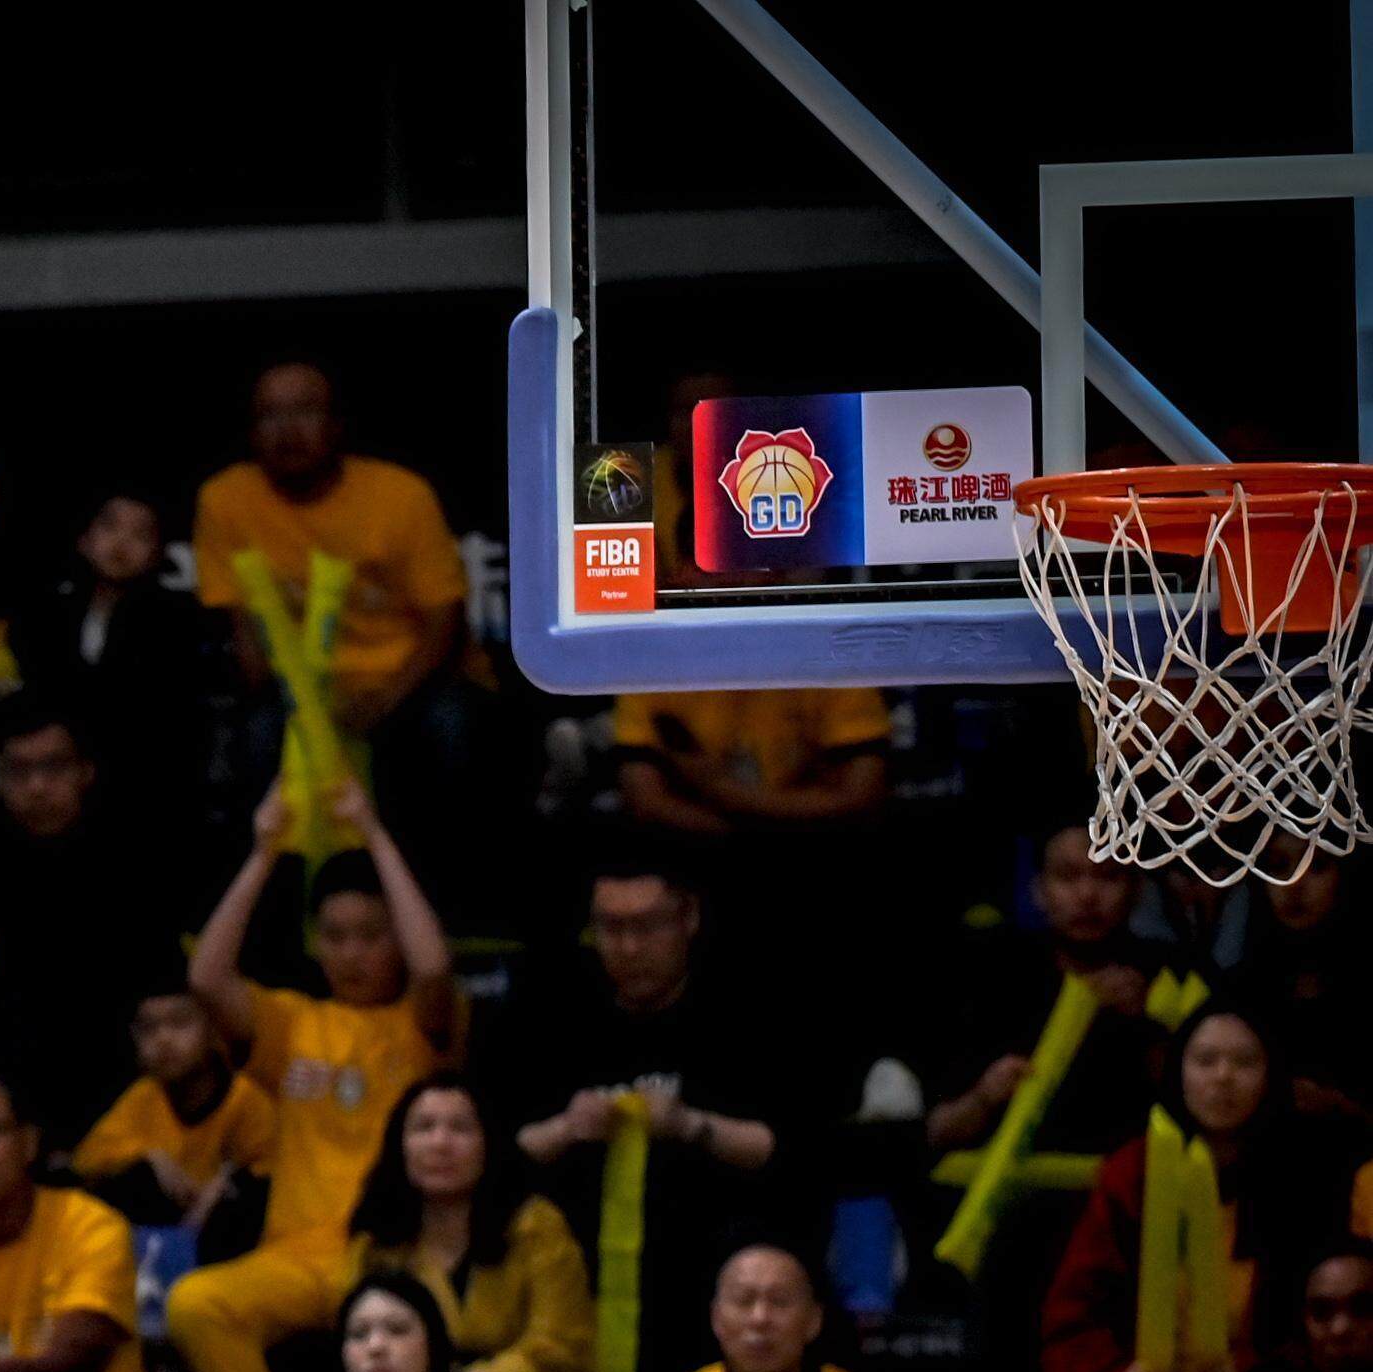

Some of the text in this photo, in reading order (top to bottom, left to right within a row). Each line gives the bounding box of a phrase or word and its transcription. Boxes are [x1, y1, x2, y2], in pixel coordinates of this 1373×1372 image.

[887, 472, 1012, 505] 珠江啤酒
[749, 494, 805, 532] GD
[899, 505, 998, 524] PEARL RIVER
[586, 537, 640, 567] FIBA
[586, 566, 640, 577] STUDY CENTRE
[601, 589, 628, 600] Partner
